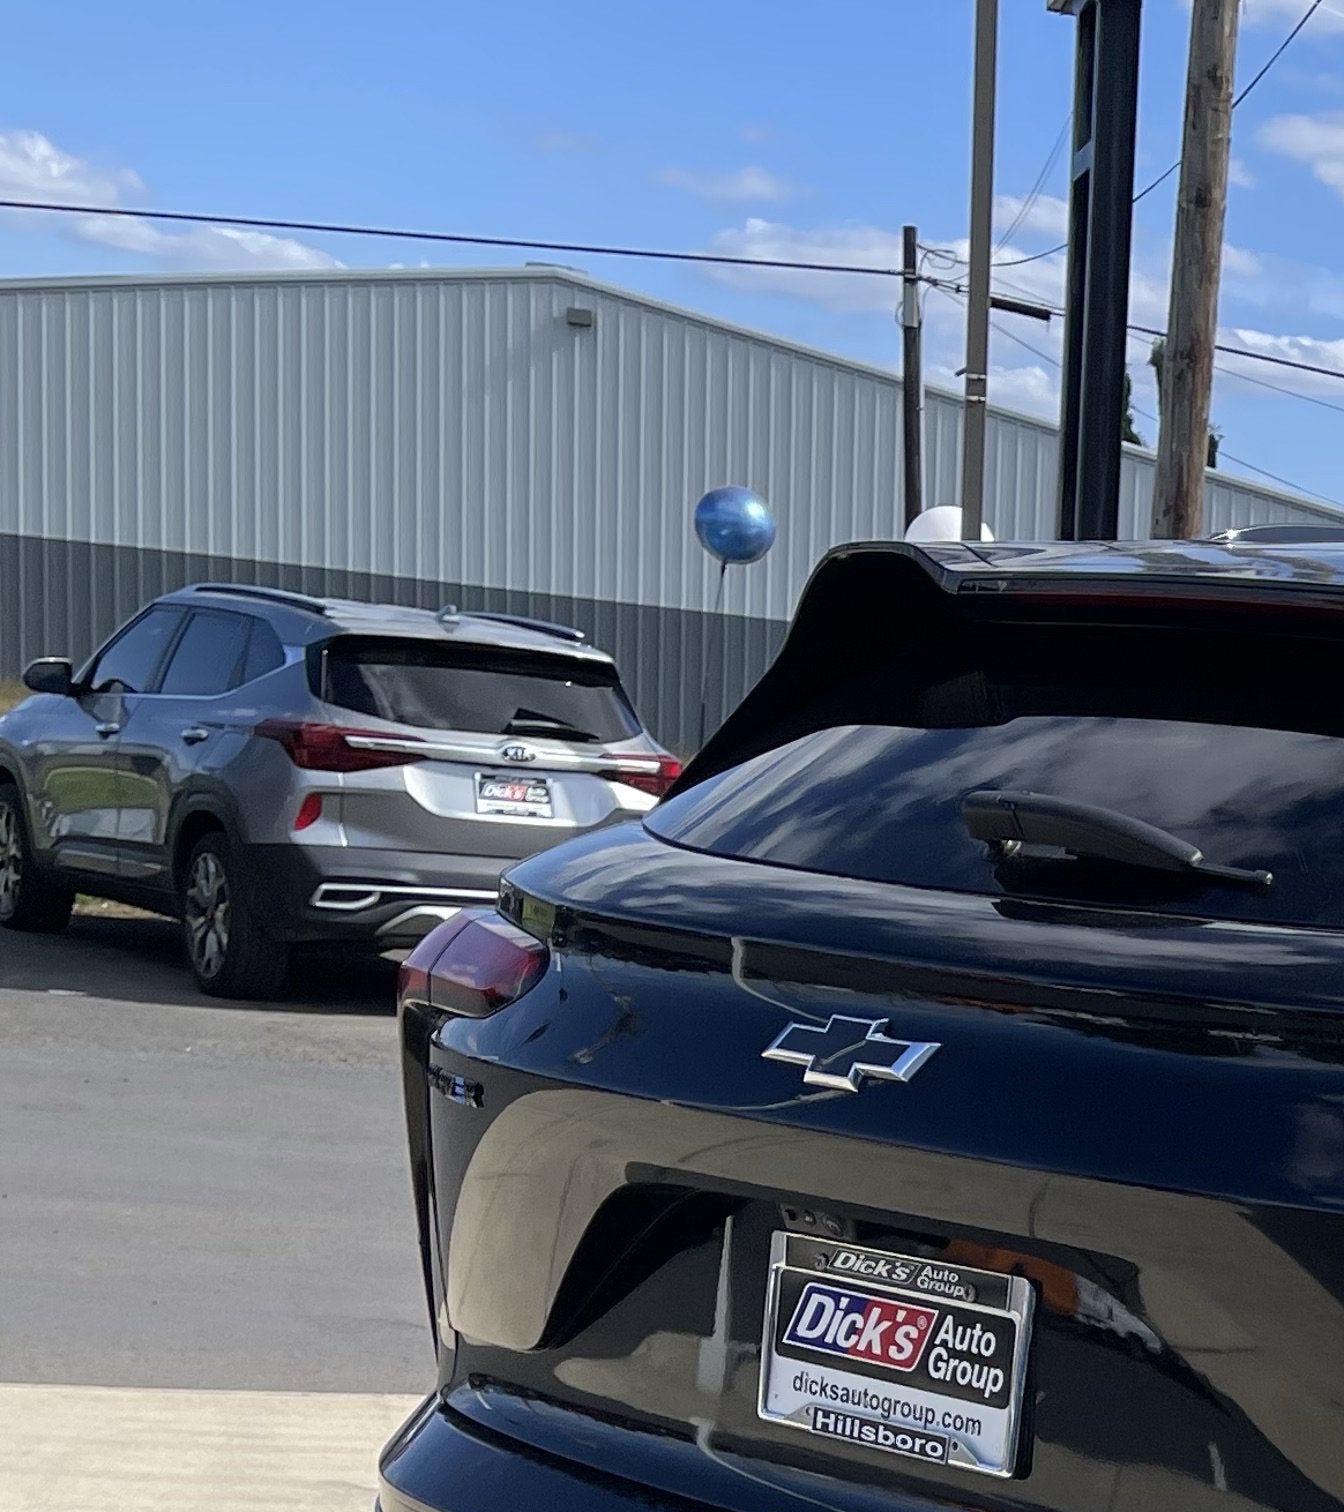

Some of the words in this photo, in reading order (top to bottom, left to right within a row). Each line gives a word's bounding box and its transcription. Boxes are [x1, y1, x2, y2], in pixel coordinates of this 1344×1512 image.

[833, 1251, 911, 1280] Dick's
[916, 1276, 966, 1298] Group
[920, 1265, 959, 1283] Auto
[796, 1292, 919, 1361] Dick's
[934, 1315, 996, 1357] Auto
[927, 1347, 1004, 1399] Group
[792, 1370, 982, 1437] dicksautogroup.com
[815, 1410, 944, 1459] Hillsboro
